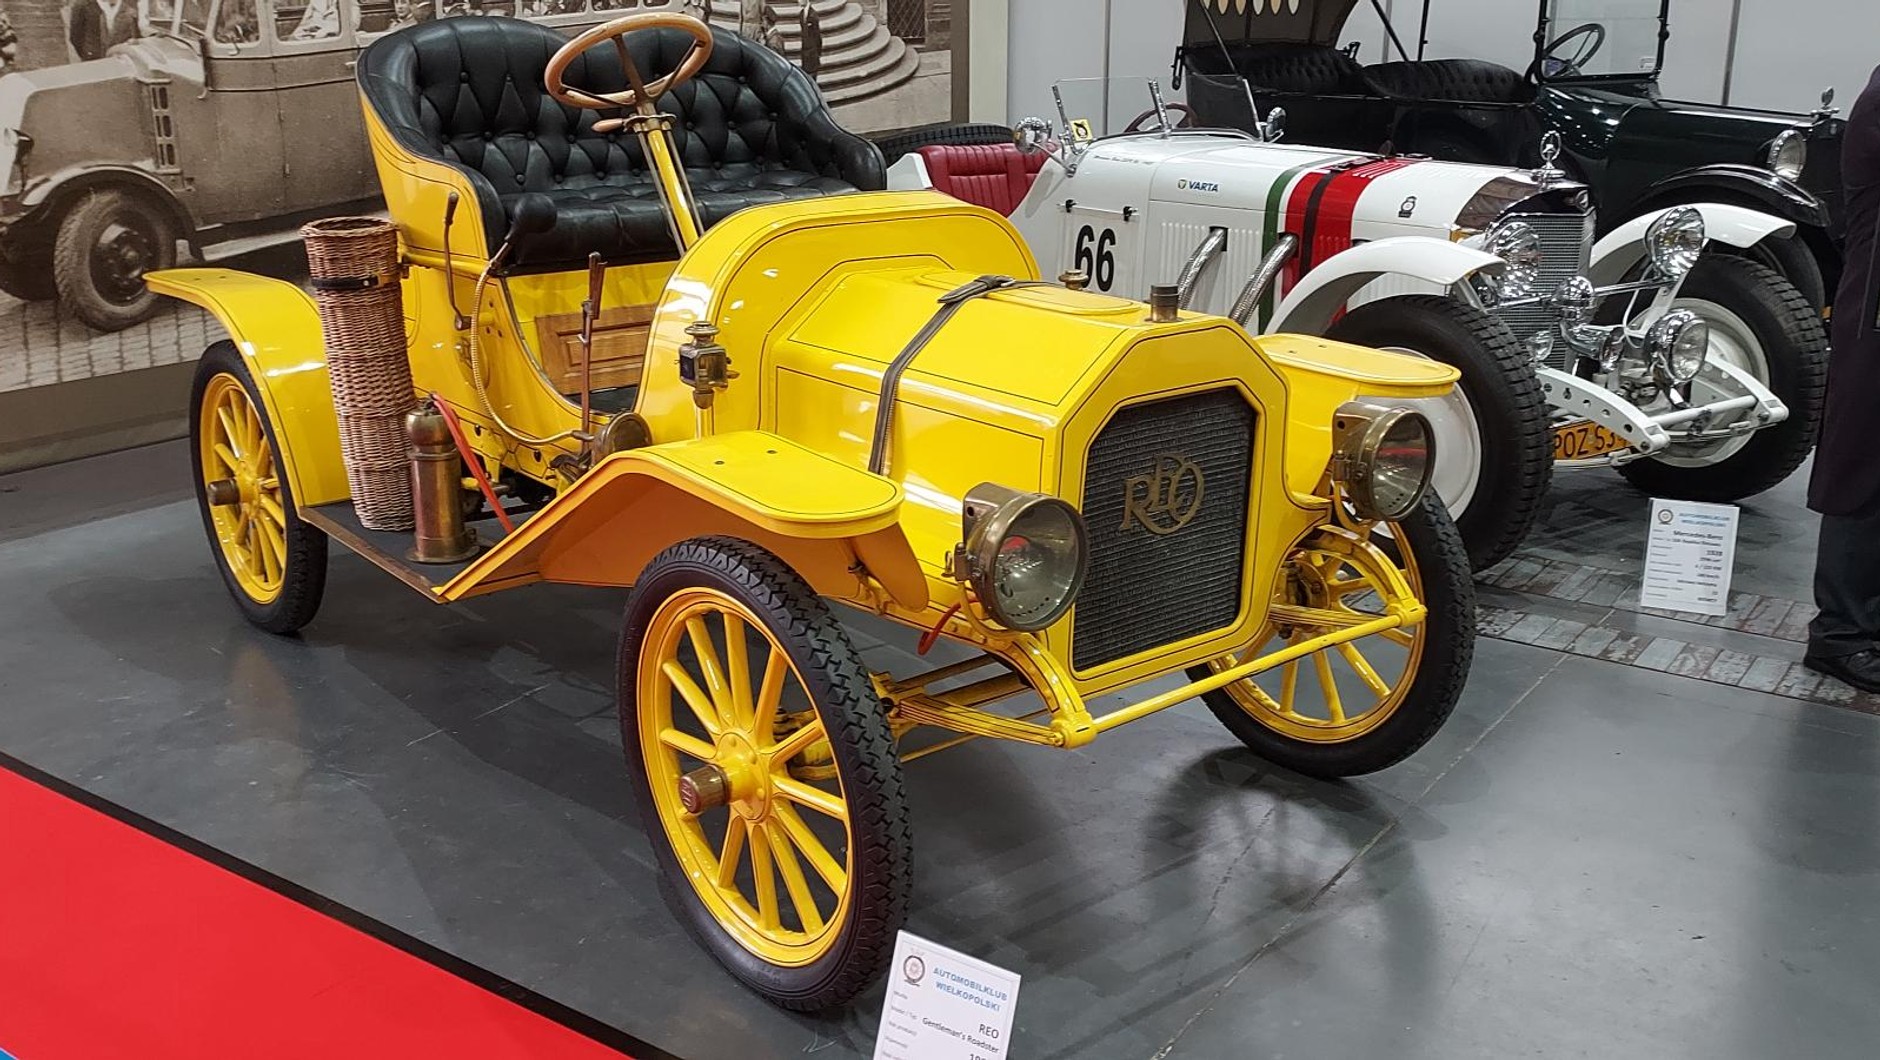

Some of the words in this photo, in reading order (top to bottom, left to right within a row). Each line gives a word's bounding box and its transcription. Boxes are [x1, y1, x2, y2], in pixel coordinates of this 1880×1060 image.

[1189, 181, 1218, 192] VARTA
[1075, 225, 1116, 292] 66
[1119, 452, 1205, 535] REO
[932, 967, 1008, 1001] AUTOMOBILKLUB
[936, 981, 1001, 1012] WIELKOPOLSKI
[922, 1017, 966, 1040] Gentleman's
[967, 1035, 999, 1053] Roadster
[979, 1023, 999, 1039] REO
